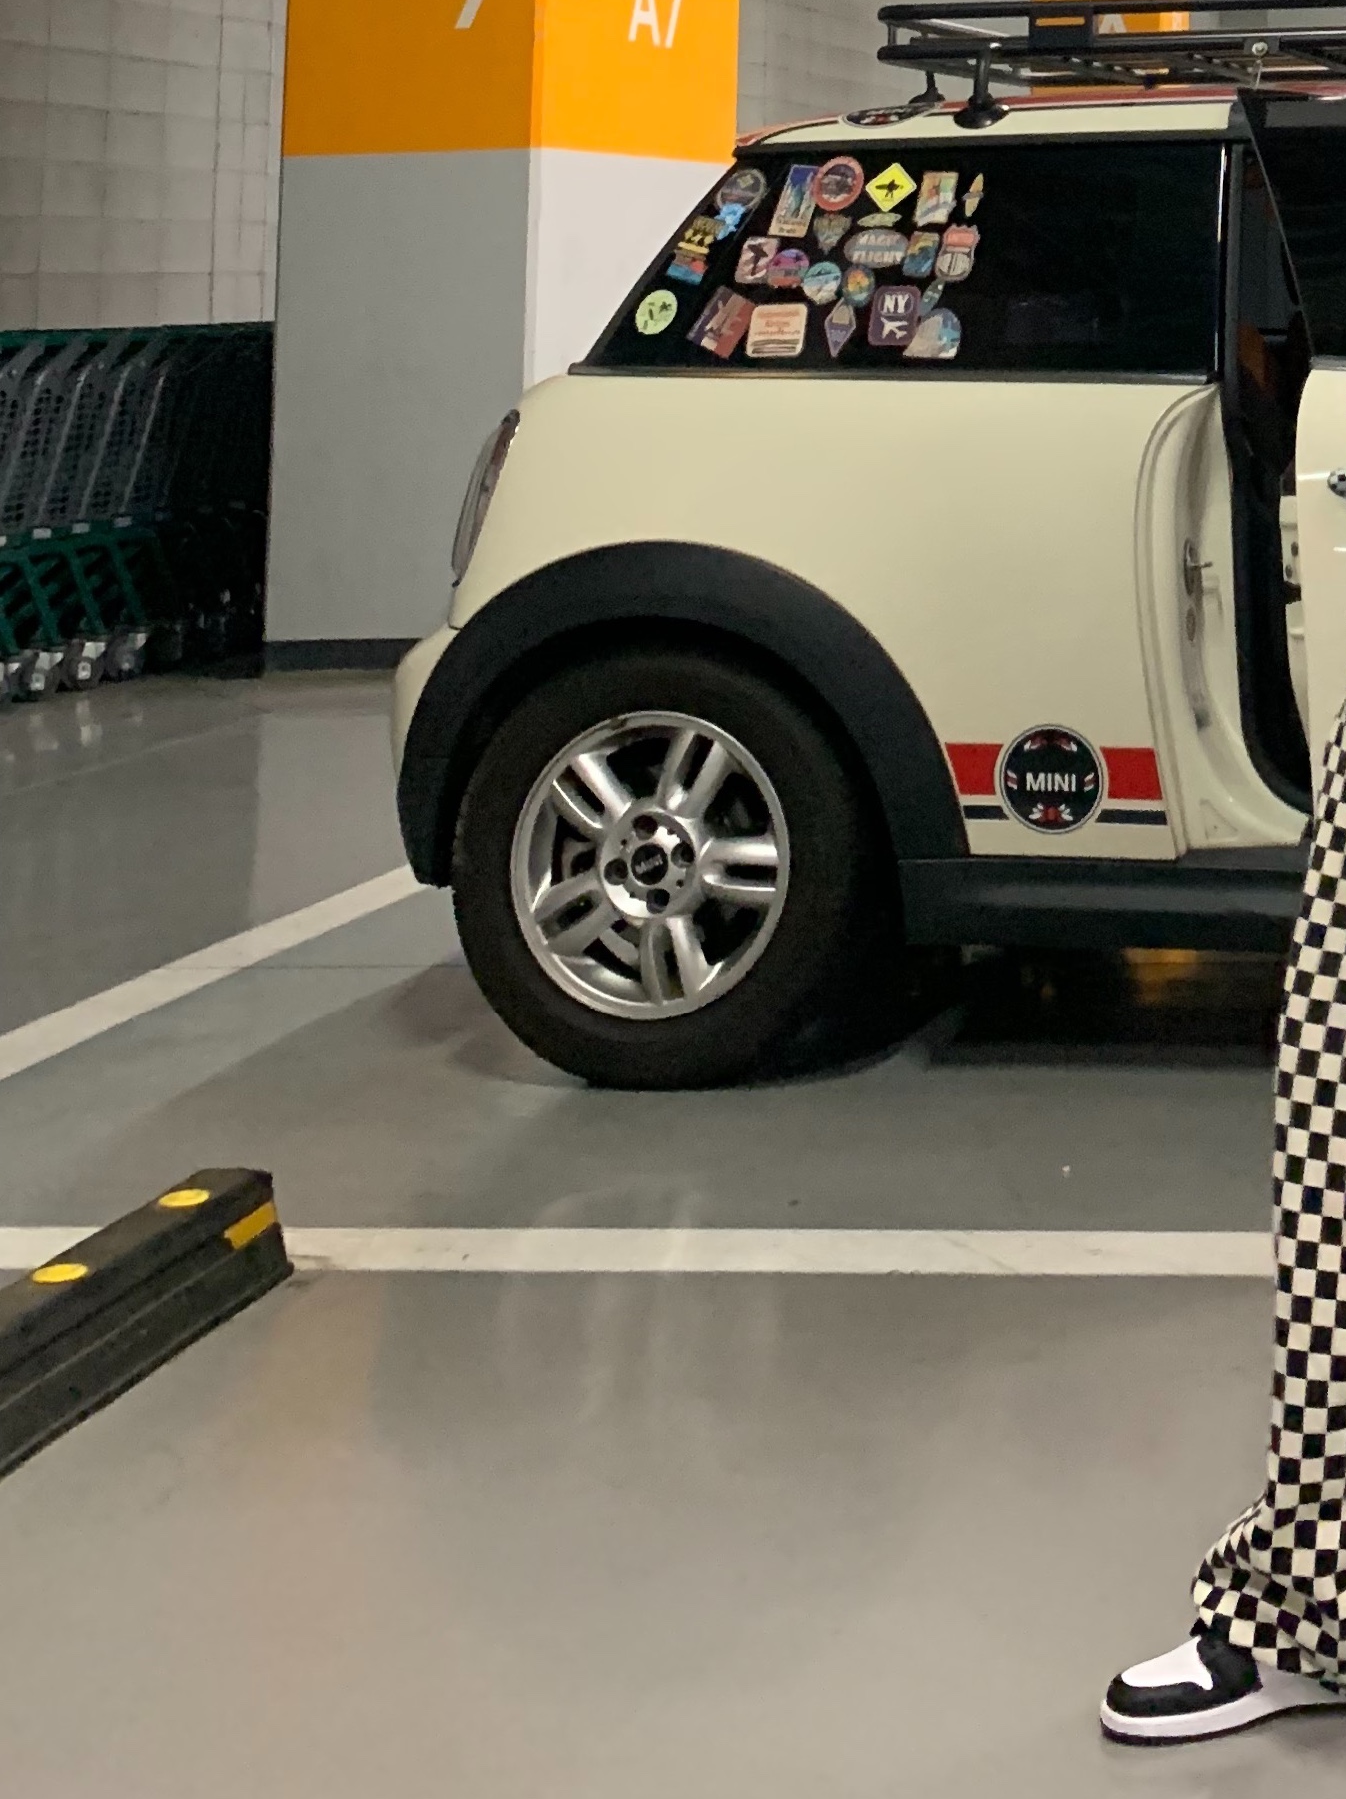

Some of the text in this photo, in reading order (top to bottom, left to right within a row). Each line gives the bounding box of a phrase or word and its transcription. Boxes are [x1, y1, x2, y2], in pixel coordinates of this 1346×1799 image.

[852, 251, 903, 263] FLIGHT
[883, 293, 910, 314] NY
[1026, 772, 1077, 792] MINI
